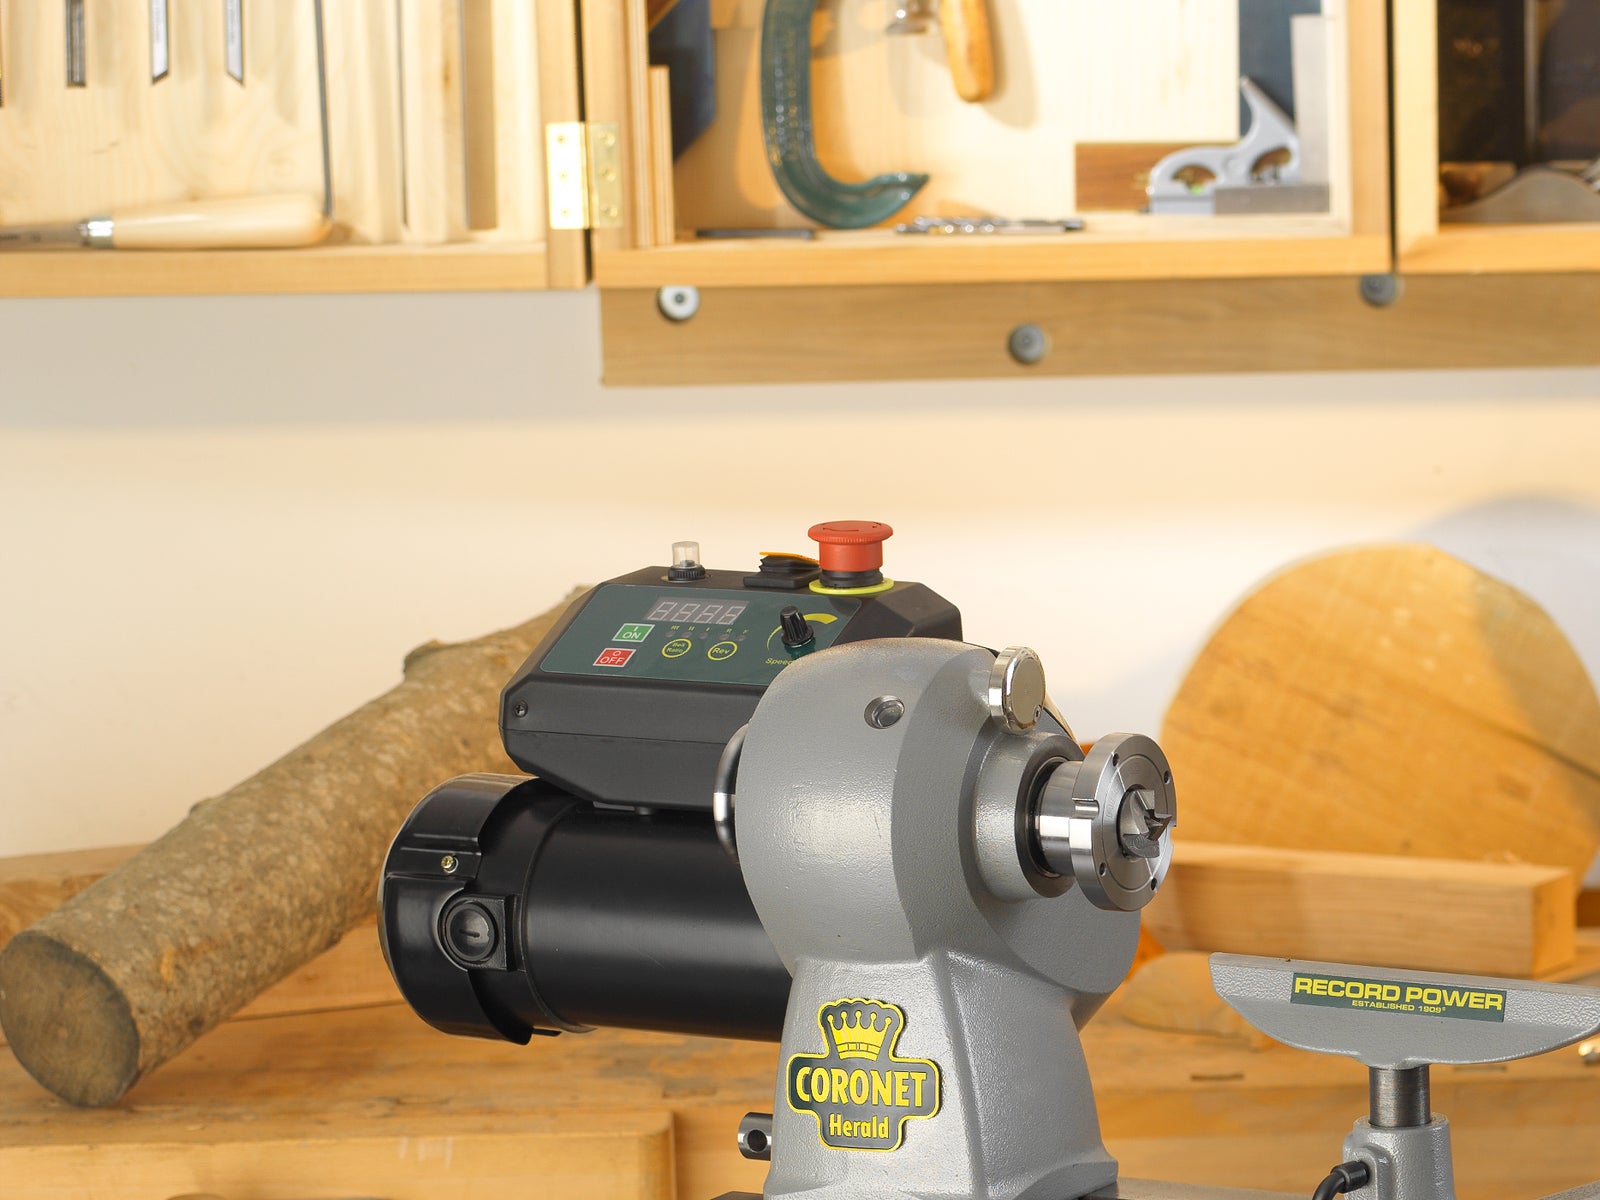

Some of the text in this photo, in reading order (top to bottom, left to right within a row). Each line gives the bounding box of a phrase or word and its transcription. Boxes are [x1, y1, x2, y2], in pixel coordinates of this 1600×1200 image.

[622, 631, 641, 640] ON
[712, 647, 730, 655] Rev
[599, 656, 625, 665] OFF
[1294, 977, 1504, 1011] RECORD POWER
[1352, 1000, 1415, 1011] ESTABLISHED
[796, 1066, 928, 1108] CORONET
[828, 1113, 890, 1139] Herald
